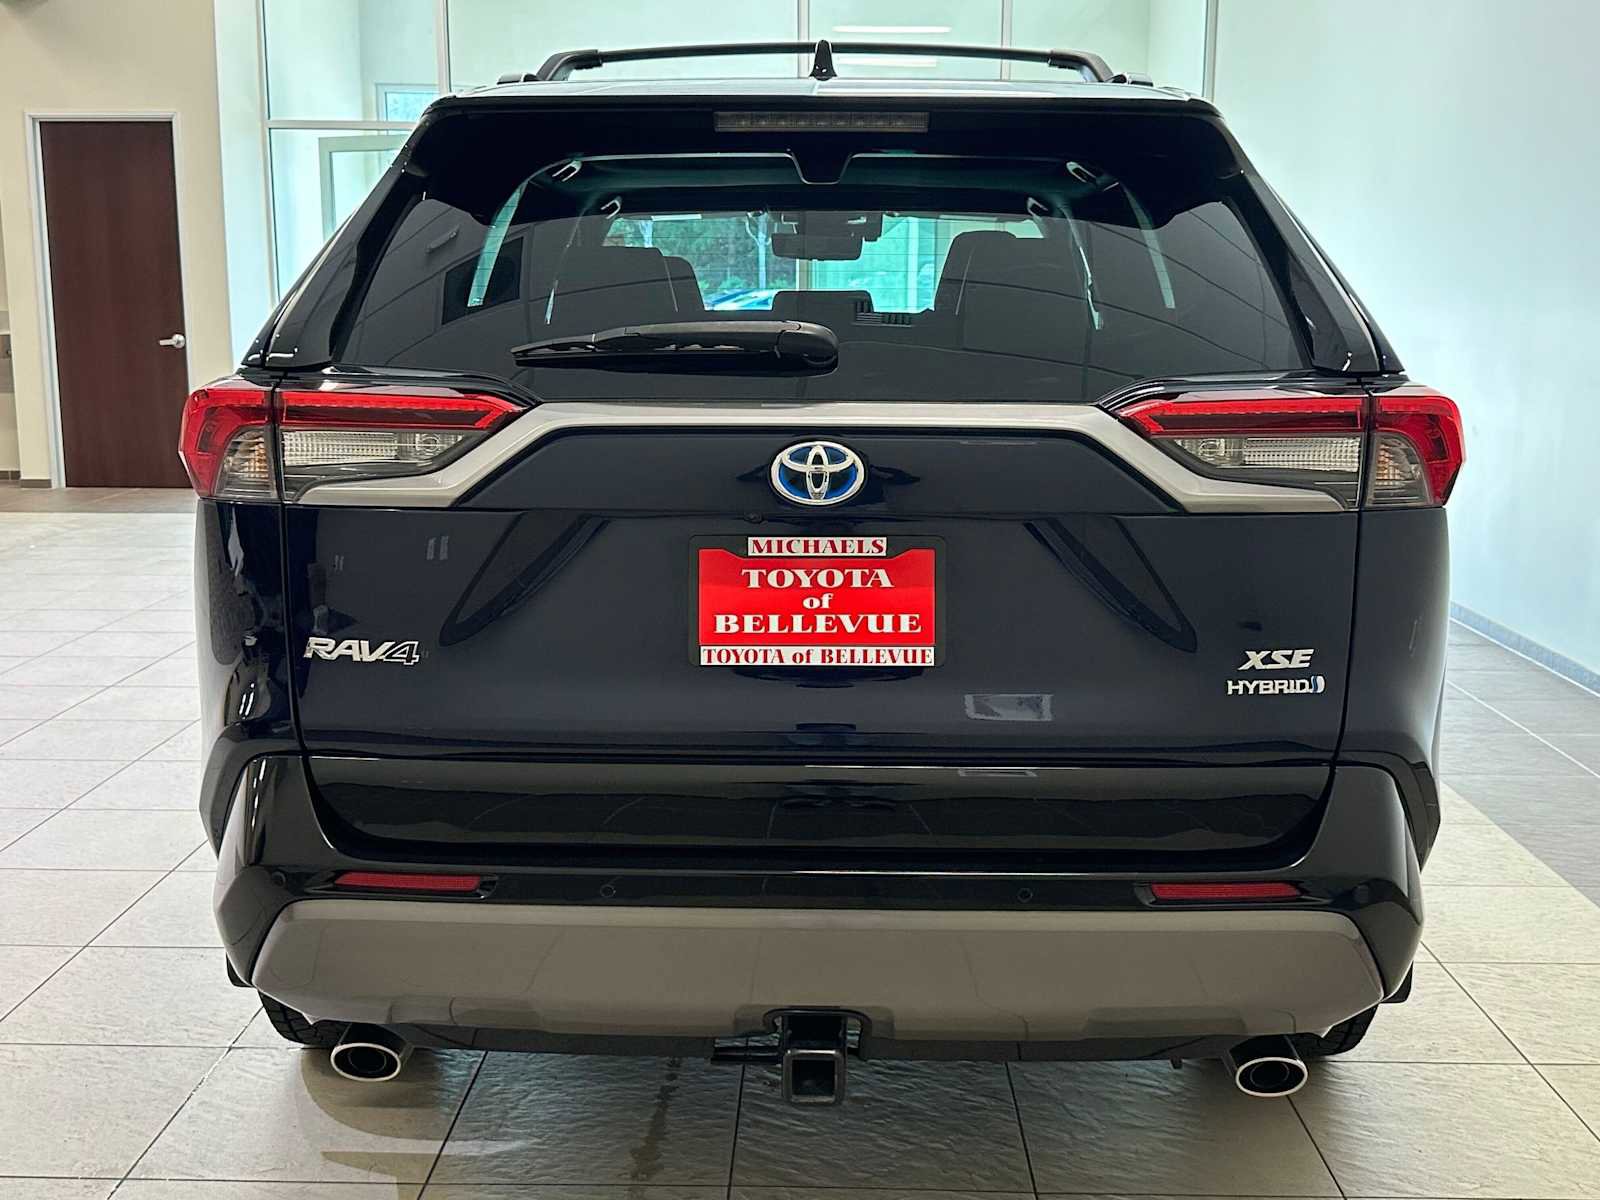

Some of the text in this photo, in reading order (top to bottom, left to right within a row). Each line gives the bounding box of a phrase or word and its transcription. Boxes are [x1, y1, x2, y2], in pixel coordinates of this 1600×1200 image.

[751, 539, 884, 554] MICHAELS
[741, 568, 894, 588] TOYOTA
[802, 593, 833, 609] of
[713, 613, 922, 634] BELLEVUE
[303, 636, 420, 665] RAV4
[703, 648, 933, 664] TOYOTA of BELLEVUE
[1237, 648, 1315, 671] XSE
[1226, 678, 1312, 695] HYBRID
